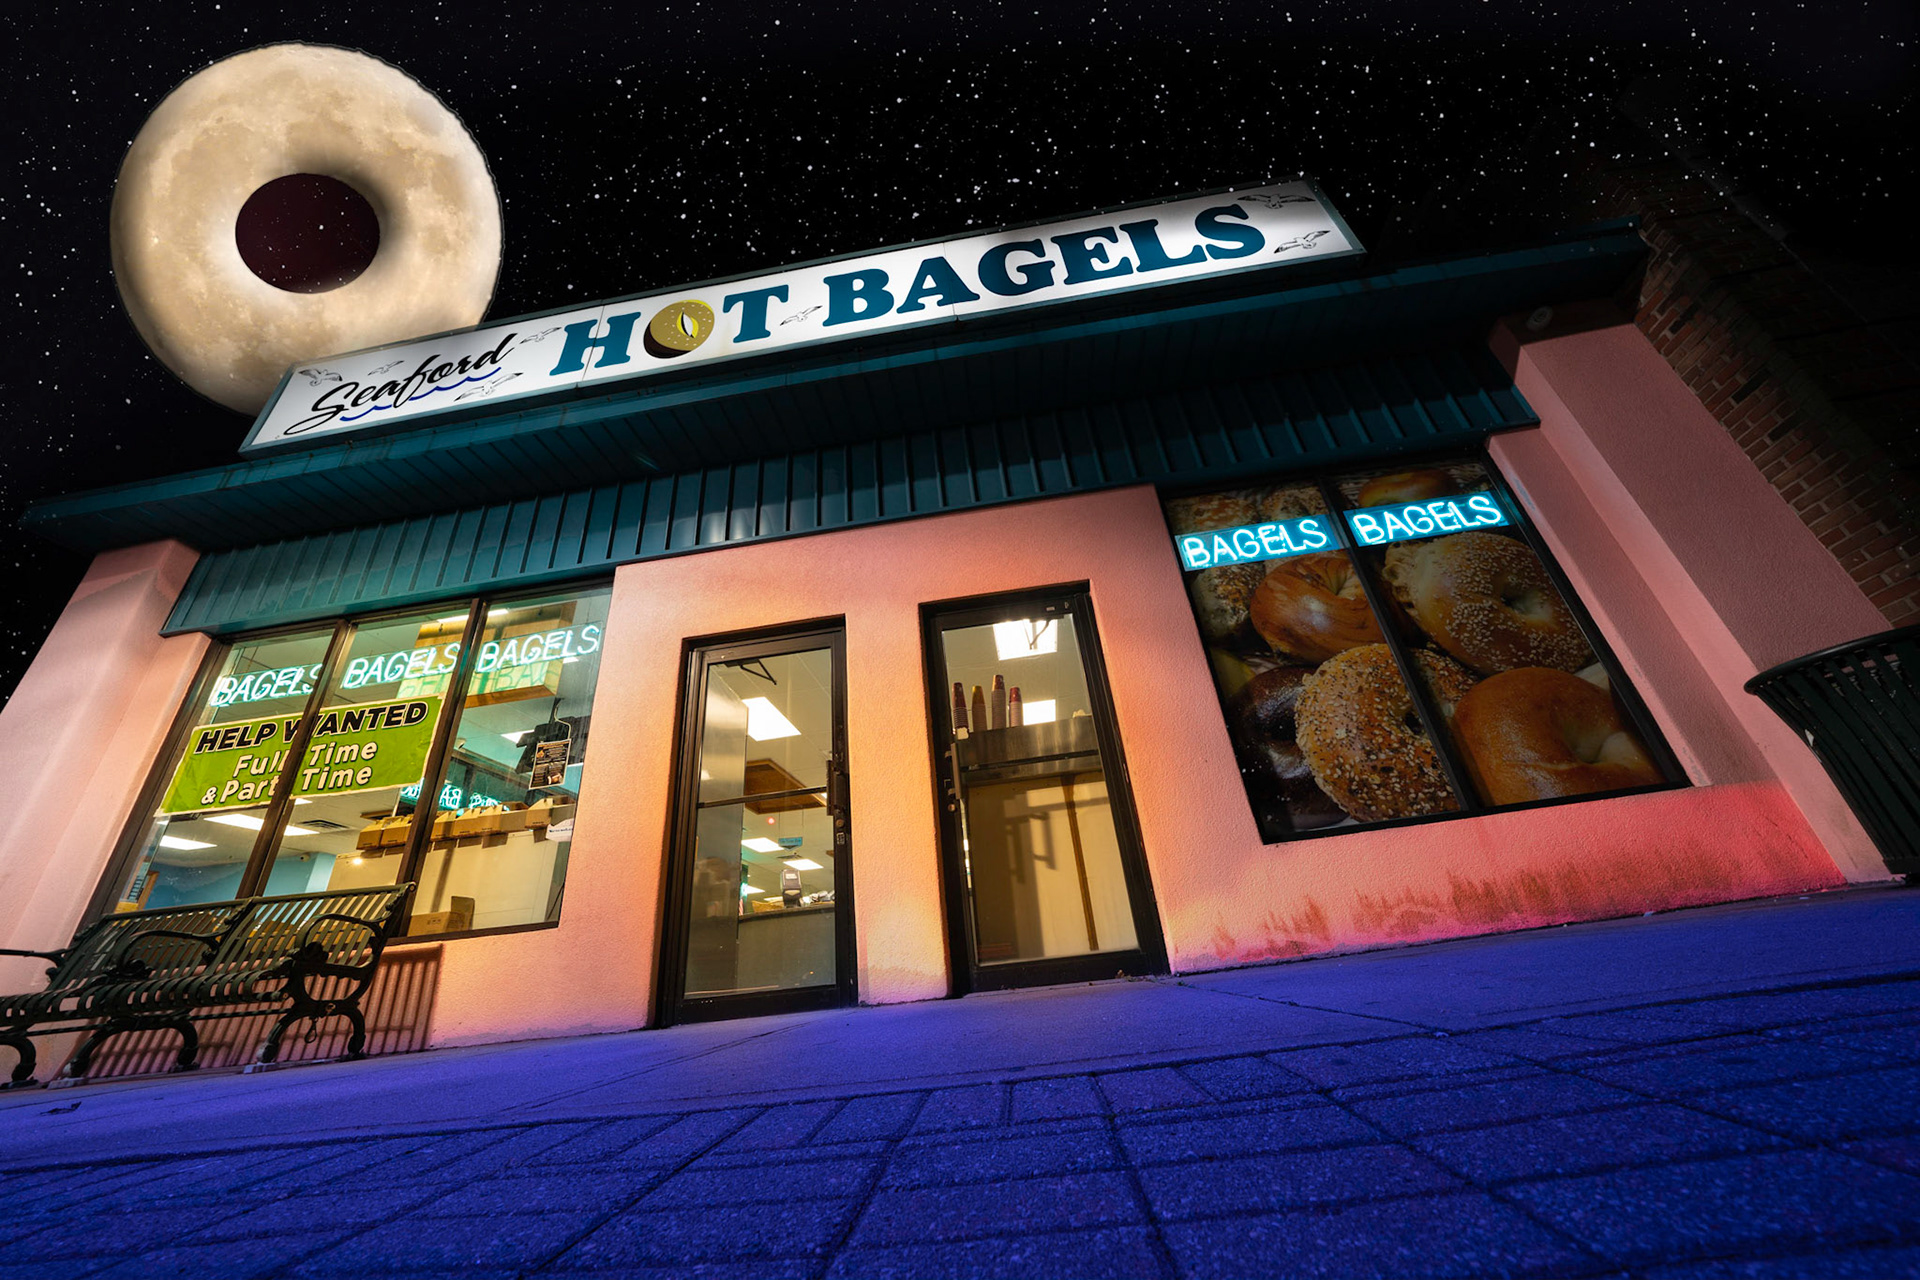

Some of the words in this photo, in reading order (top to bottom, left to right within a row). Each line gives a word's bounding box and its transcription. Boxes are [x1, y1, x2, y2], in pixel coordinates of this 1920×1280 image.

[284, 332, 517, 436] Seaford
[549, 284, 789, 377] HOT
[822, 203, 1266, 326] BAGELS
[1182, 519, 1328, 568] BAGELS
[1352, 495, 1502, 545] BAGELS
[342, 642, 461, 689] BAGELS
[477, 625, 600, 673] BAGELS
[193, 722, 277, 755] HELP
[232, 750, 290, 778] Full
[308, 741, 378, 767] Time
[201, 786, 218, 805] &
[219, 775, 281, 804] Part
[301, 766, 372, 791] Time
